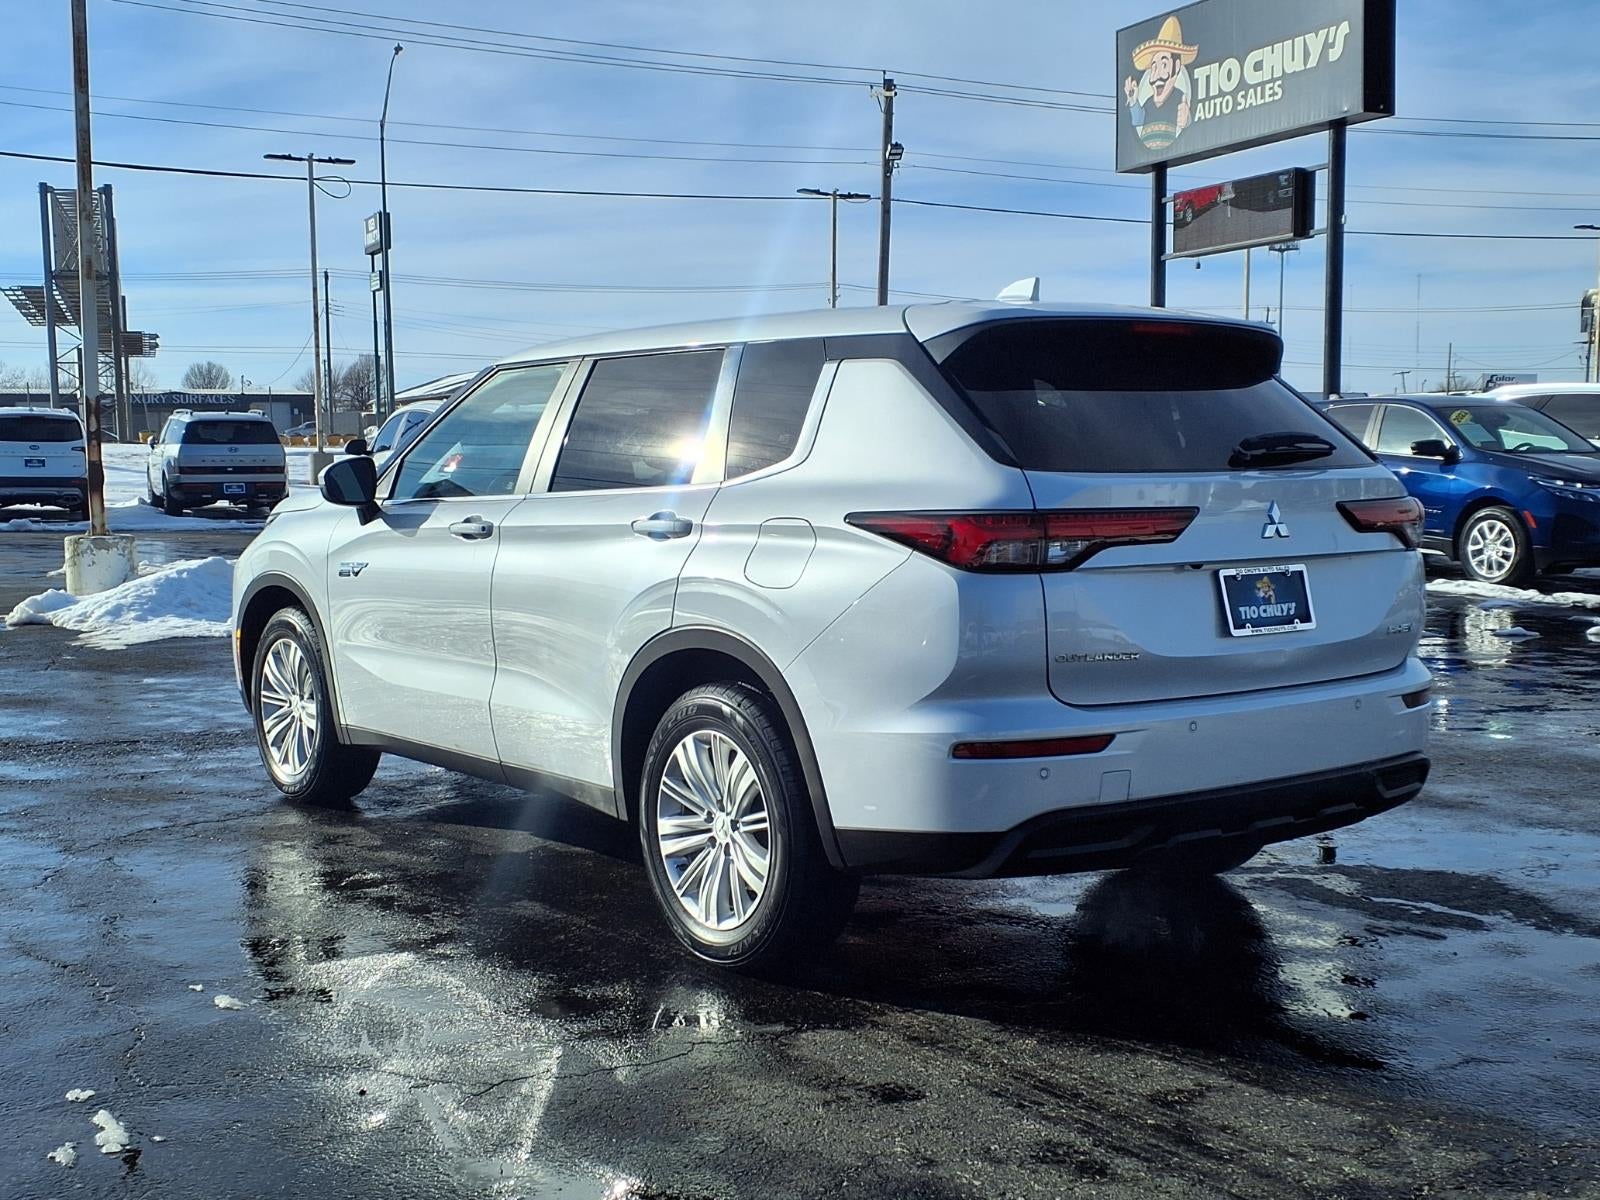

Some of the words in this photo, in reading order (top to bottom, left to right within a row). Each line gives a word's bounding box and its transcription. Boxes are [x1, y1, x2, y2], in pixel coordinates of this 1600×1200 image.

[1194, 57, 1241, 100] TIO
[1243, 20, 1350, 85] CHUY'S
[1194, 95, 1233, 122] AUTO
[1236, 80, 1283, 111] SALES
[172, 394, 236, 404] SURFACES
[1239, 605, 1259, 620] TIO
[1259, 602, 1296, 618] CHUY'S
[1055, 652, 1139, 663] OUTLANDER
